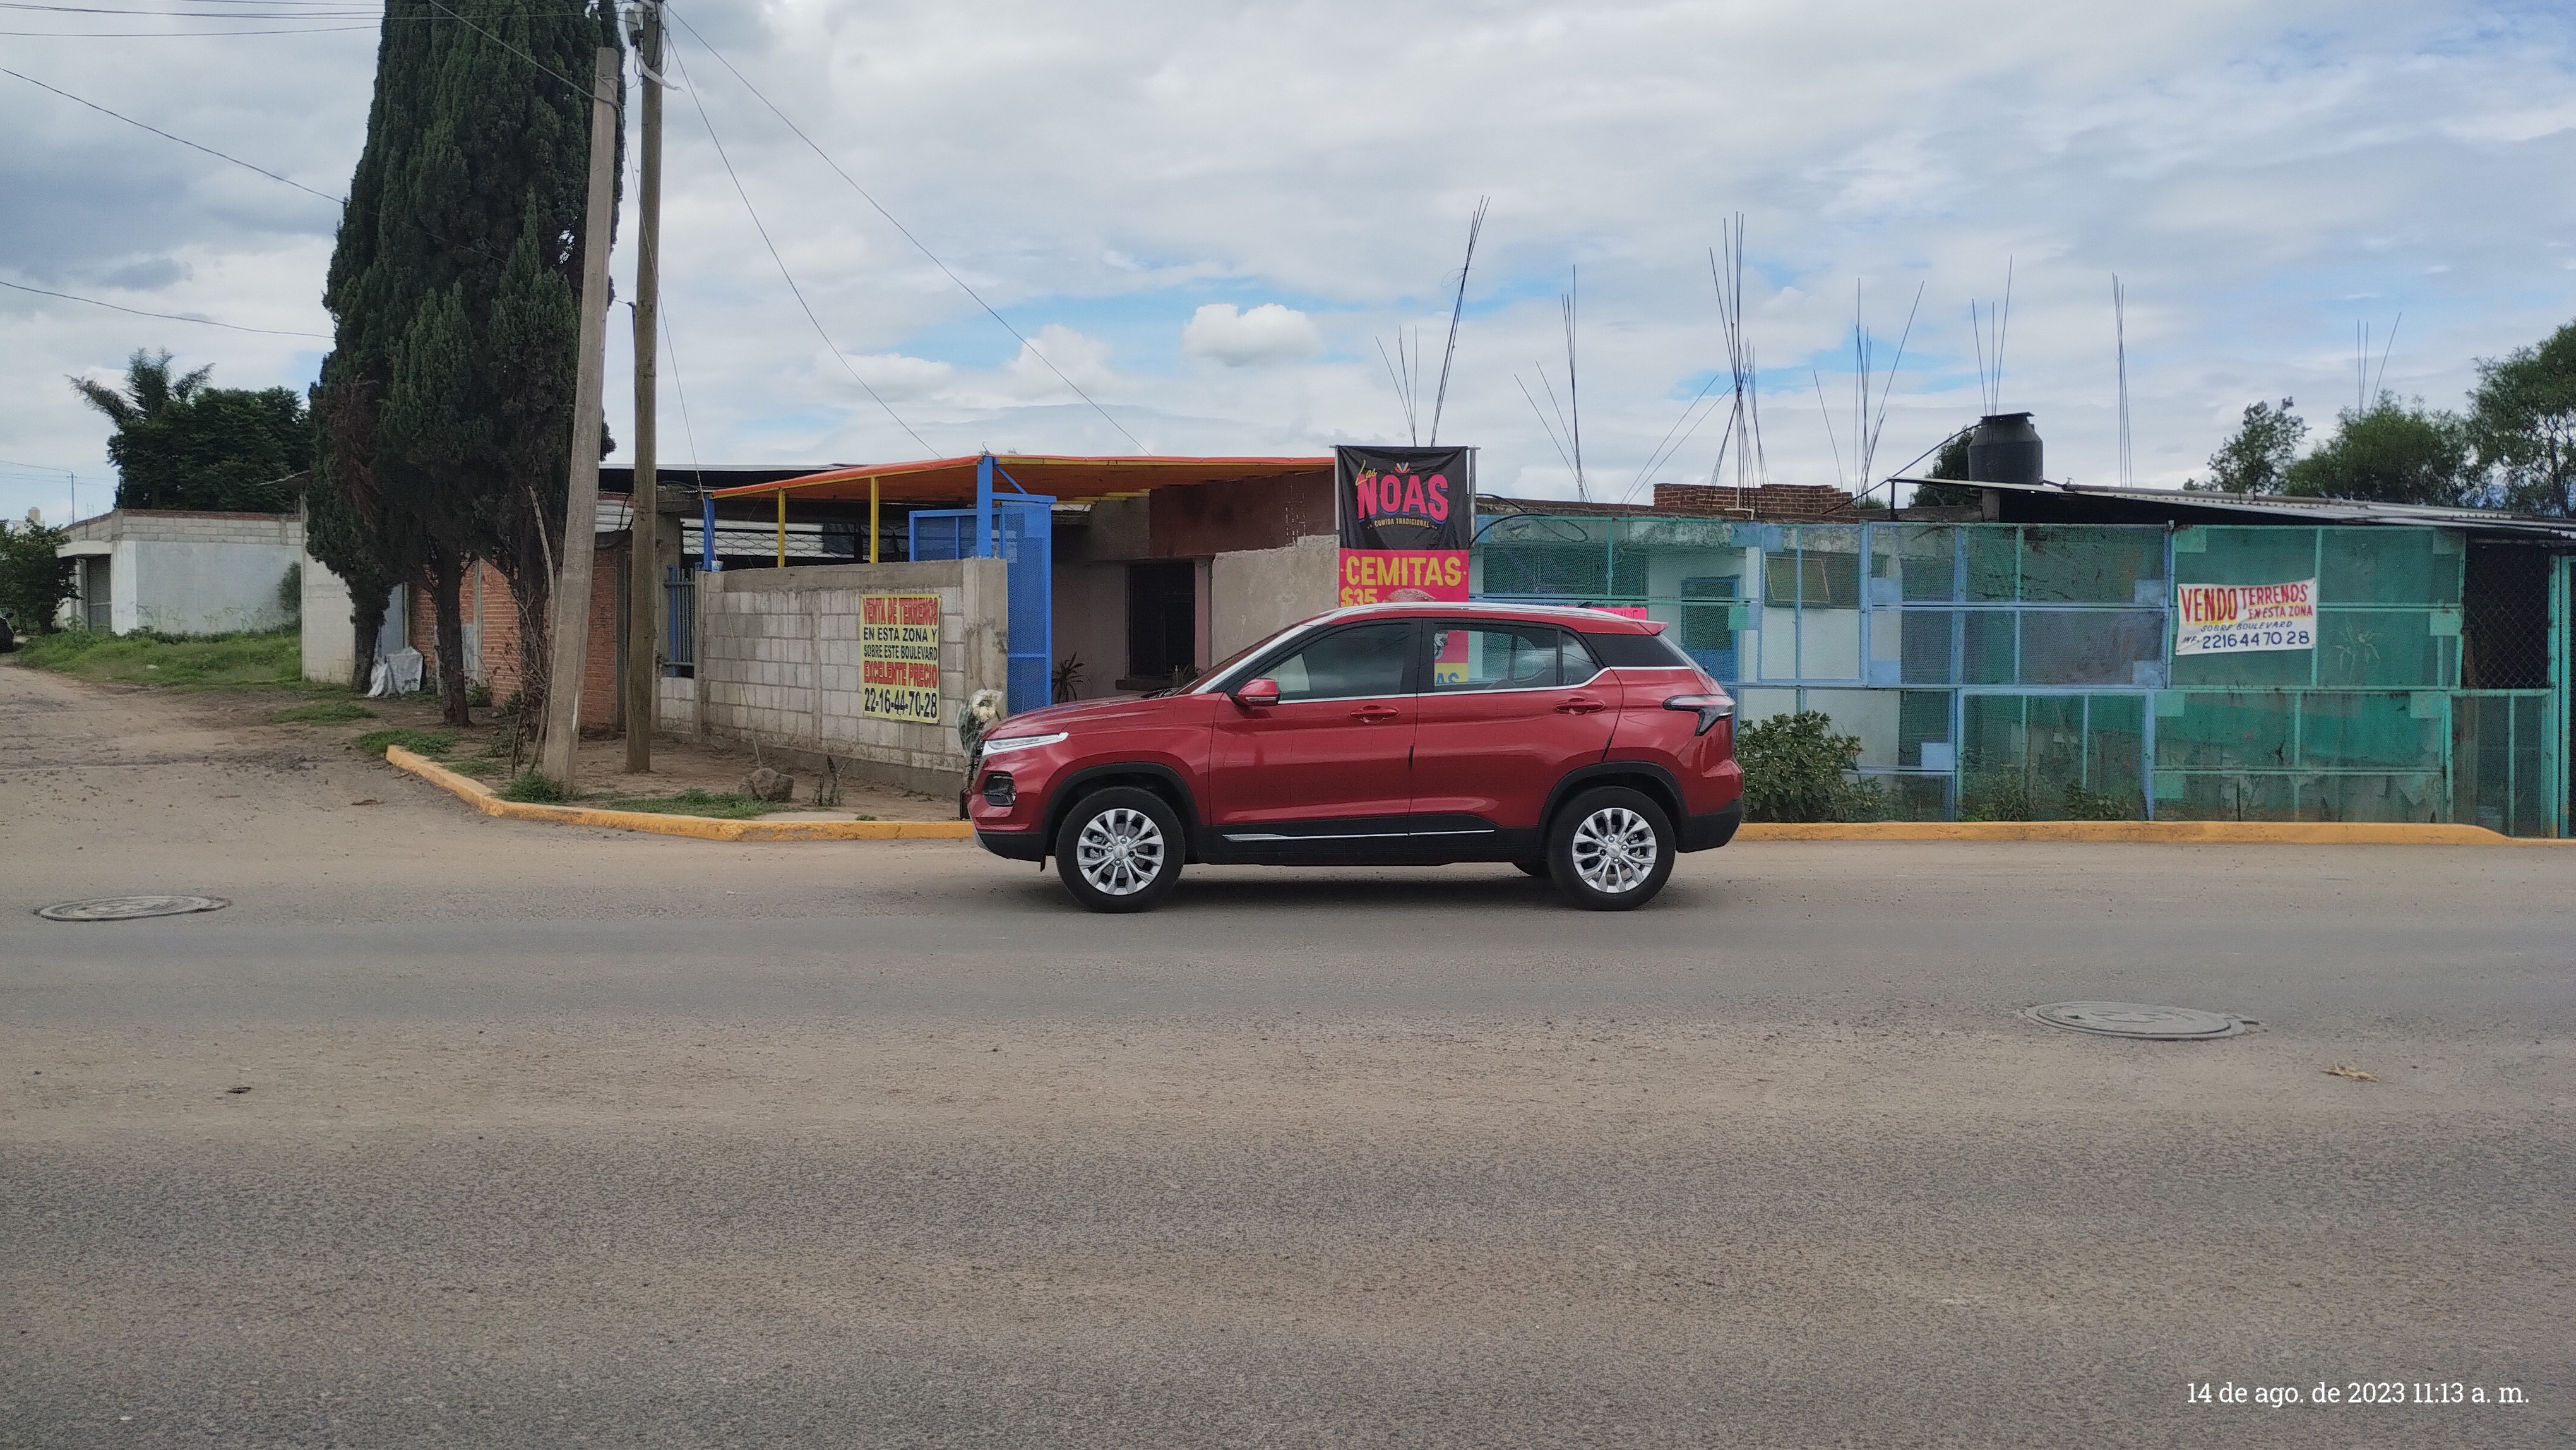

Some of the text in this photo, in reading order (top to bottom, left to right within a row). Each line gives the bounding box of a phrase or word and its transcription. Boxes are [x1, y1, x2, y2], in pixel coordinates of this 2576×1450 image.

[1355, 460, 1377, 486] Las
[1357, 474, 1448, 524] NOAS
[1374, 518, 1429, 527] COMIDA TRADICIONAL
[1345, 556, 1462, 587] CEMITAS
[863, 597, 938, 626] VENTA DE TERRENOS
[2181, 584, 2308, 623] VENDO TERRENOS
[2289, 604, 2313, 616] ZONA
[864, 627, 938, 642] EN ESTA ZONA Y
[2200, 621, 2293, 632] SOBRE BOULEVARD
[864, 644, 938, 661] SOBRE ESTE BOULEVARD
[864, 661, 938, 688] EXCELENTE PRECIO
